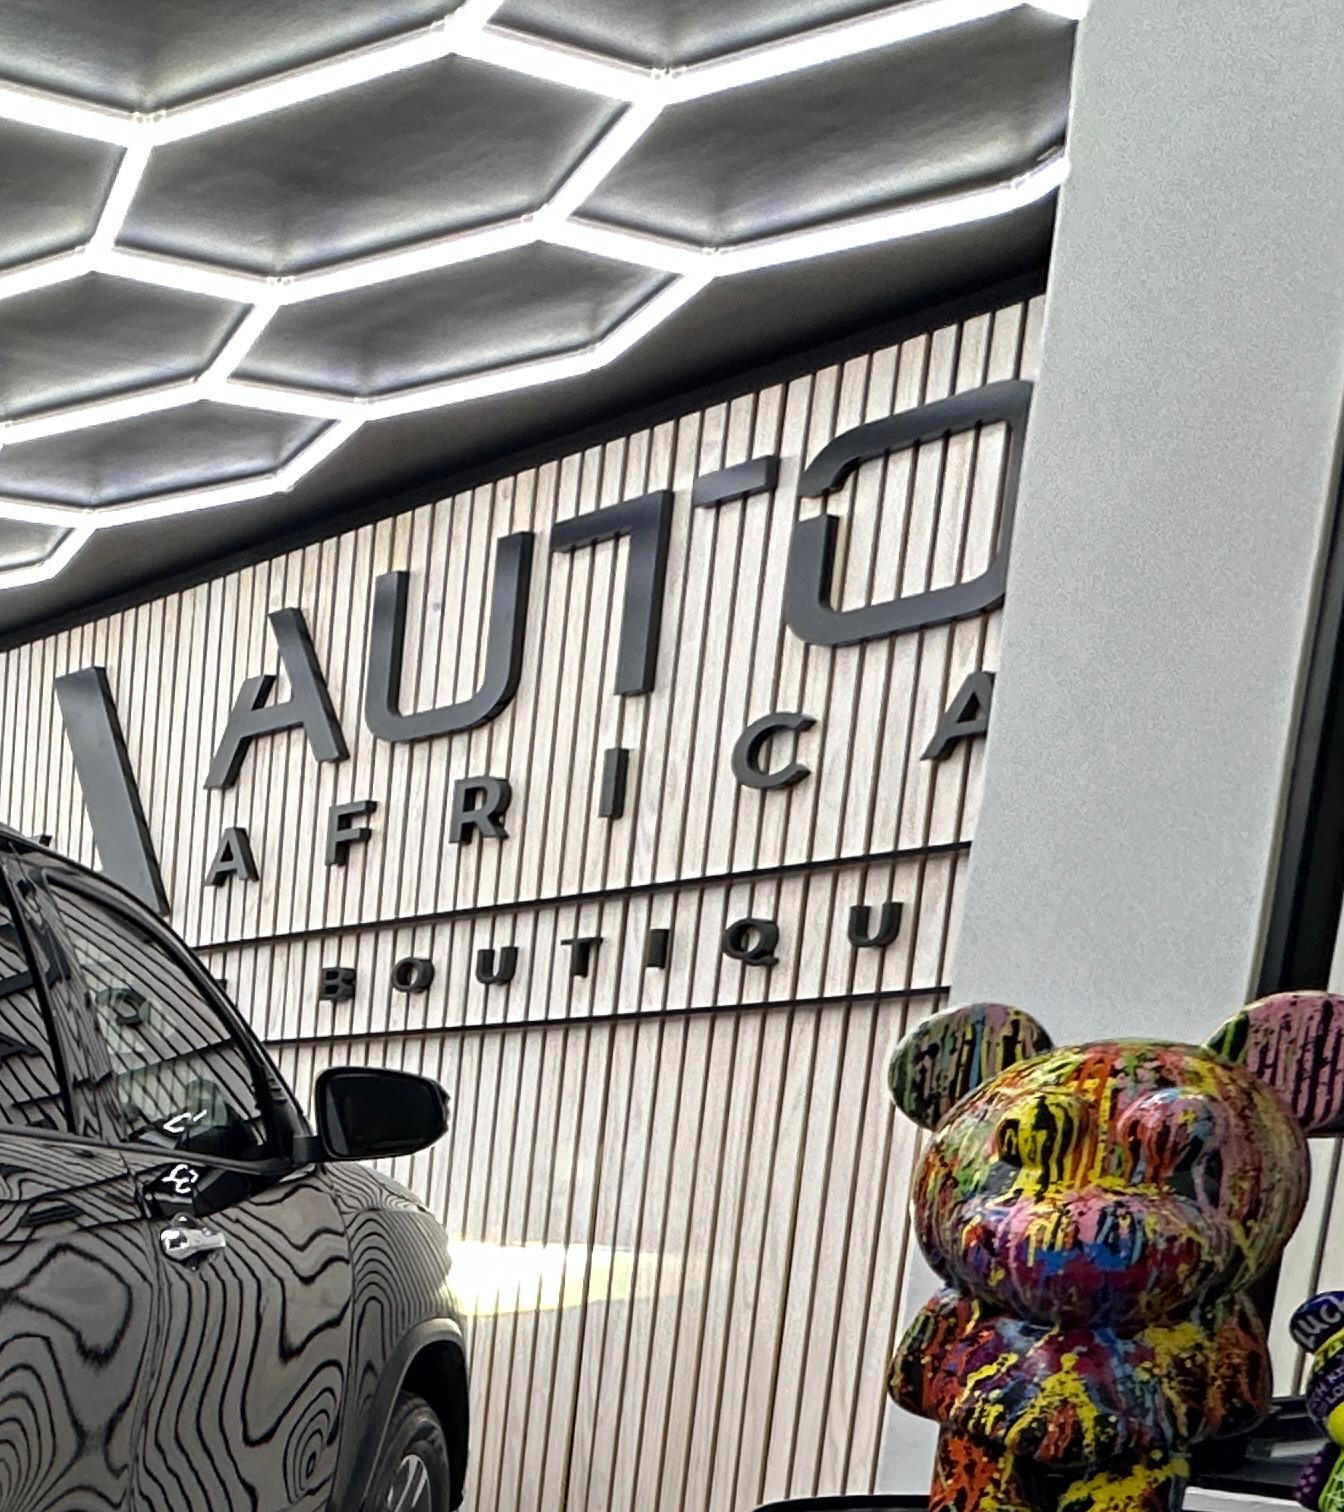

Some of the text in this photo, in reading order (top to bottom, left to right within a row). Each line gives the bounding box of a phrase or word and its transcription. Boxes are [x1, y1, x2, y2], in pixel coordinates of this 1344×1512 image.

[204, 379, 1034, 790] AUTO
[204, 670, 996, 888] AFRICA
[317, 901, 905, 1001] BOUTIQU
